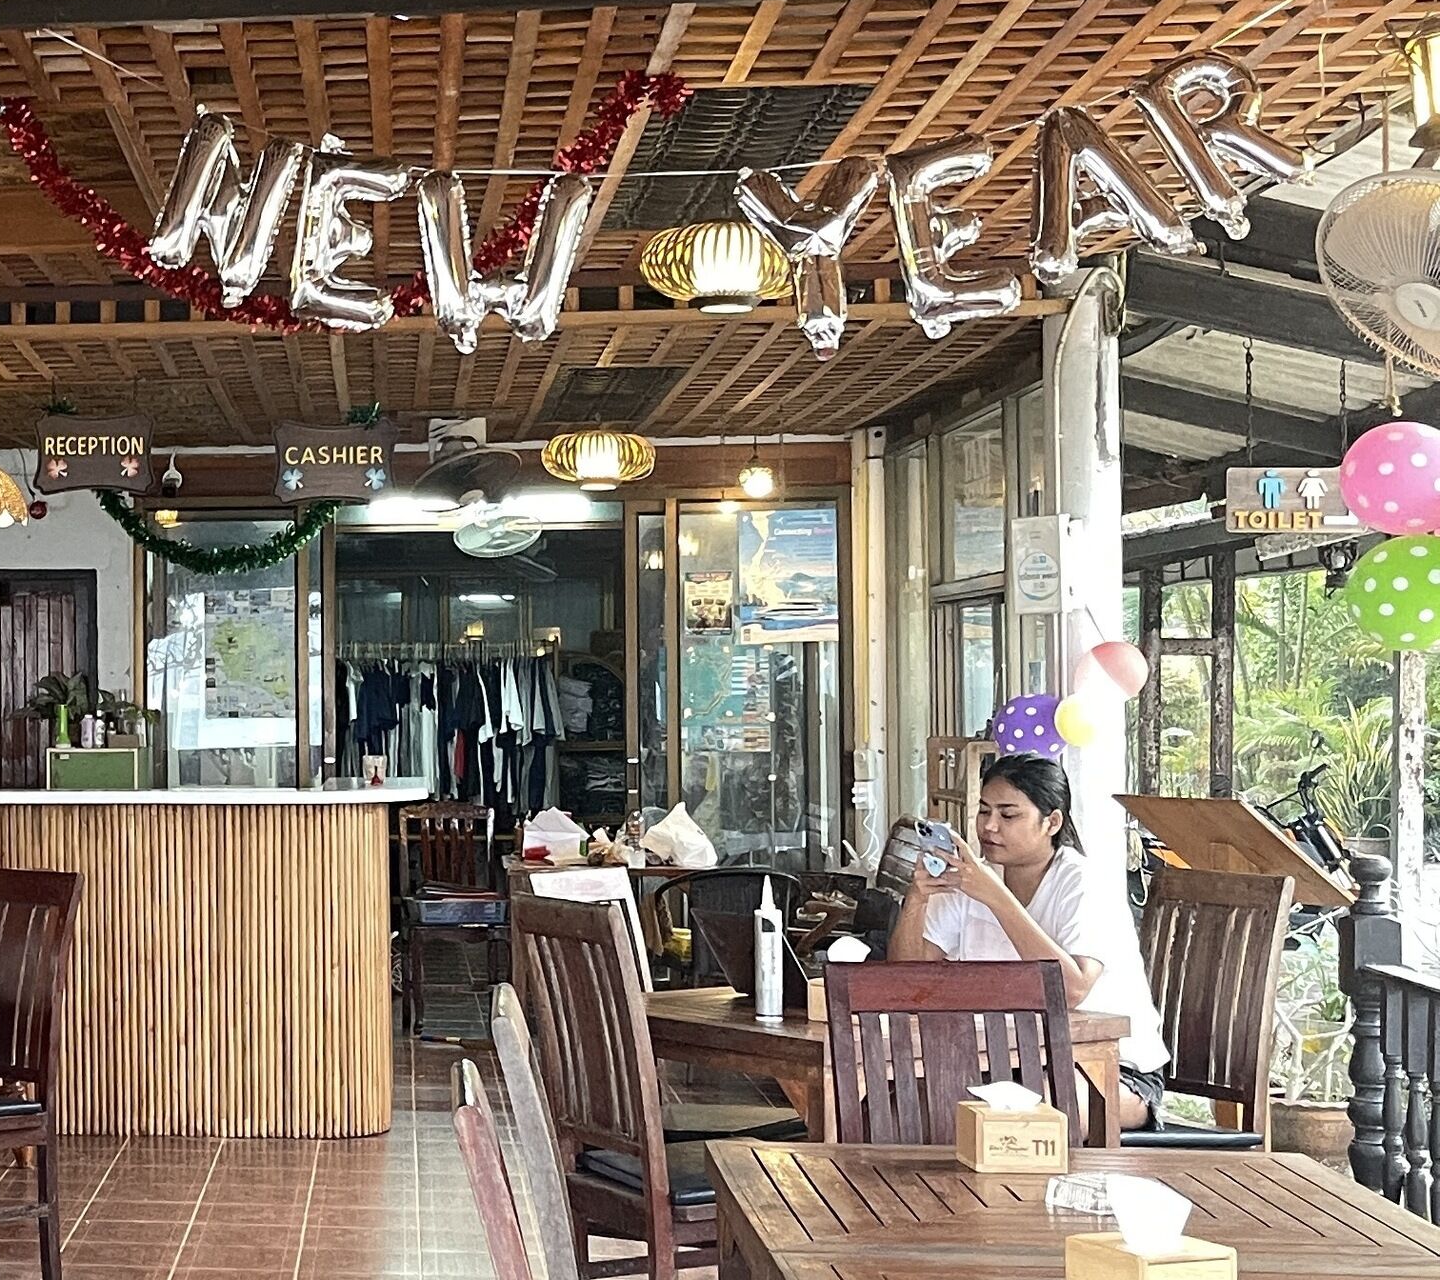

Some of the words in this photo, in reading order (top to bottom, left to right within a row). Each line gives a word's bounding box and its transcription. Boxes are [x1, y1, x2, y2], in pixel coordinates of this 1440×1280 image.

[148, 104, 594, 355] NEW
[733, 49, 1316, 361] YEAR
[44, 435, 145, 456] RECEPTION
[284, 445, 384, 466] CASHIER
[1233, 510, 1323, 529] TOILET
[1032, 1139, 1056, 1156] T11
